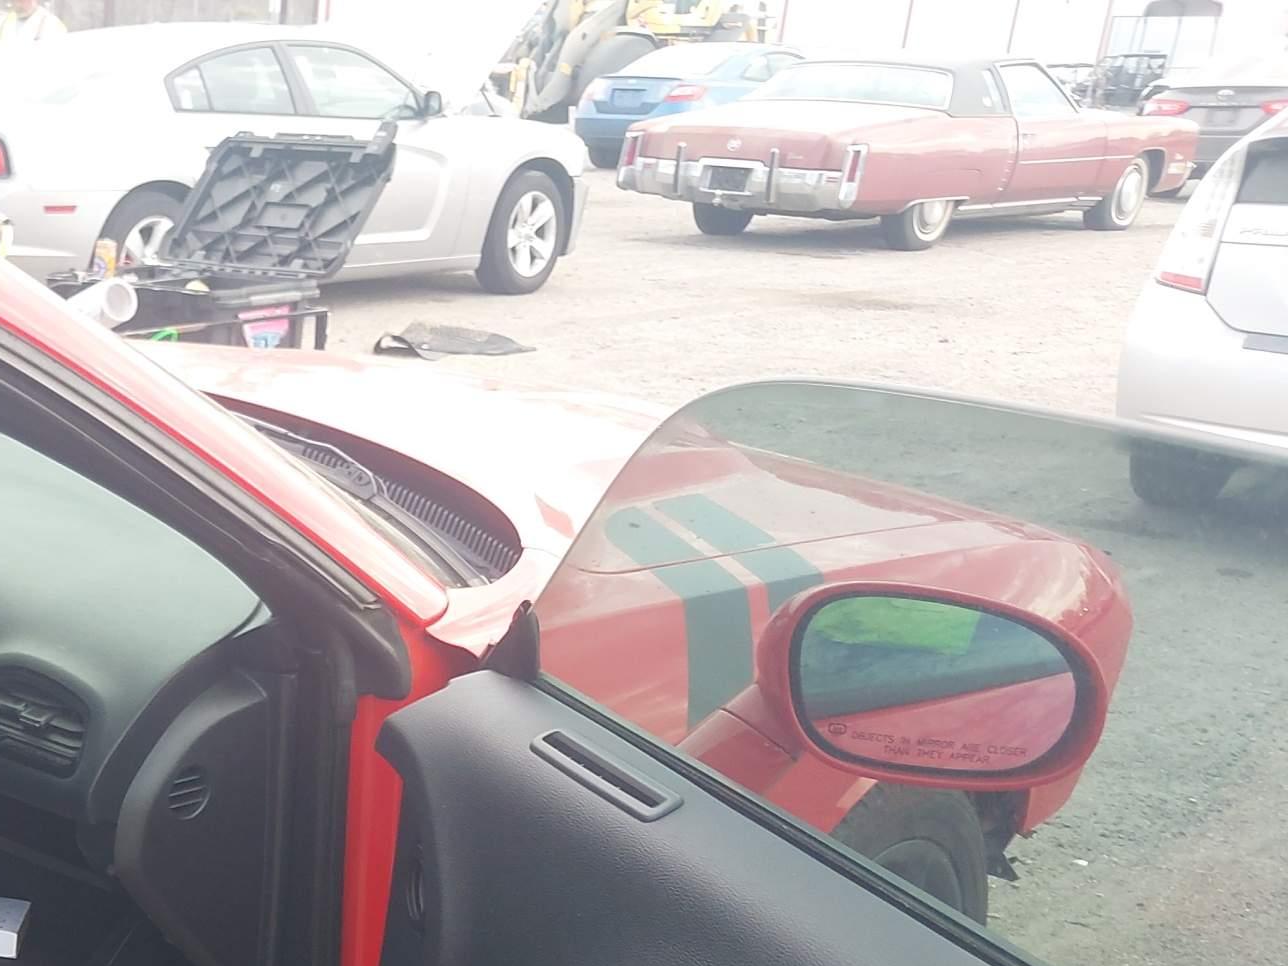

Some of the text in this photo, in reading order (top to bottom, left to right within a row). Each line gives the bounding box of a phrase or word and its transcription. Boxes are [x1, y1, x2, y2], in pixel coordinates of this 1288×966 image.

[850, 730, 895, 744] OBJECTS
[916, 738, 956, 750] MIRROR
[960, 743, 982, 753] ARE
[986, 745, 1028, 757] CLOSER
[883, 745, 991, 764] THAN THEY APPEAR
